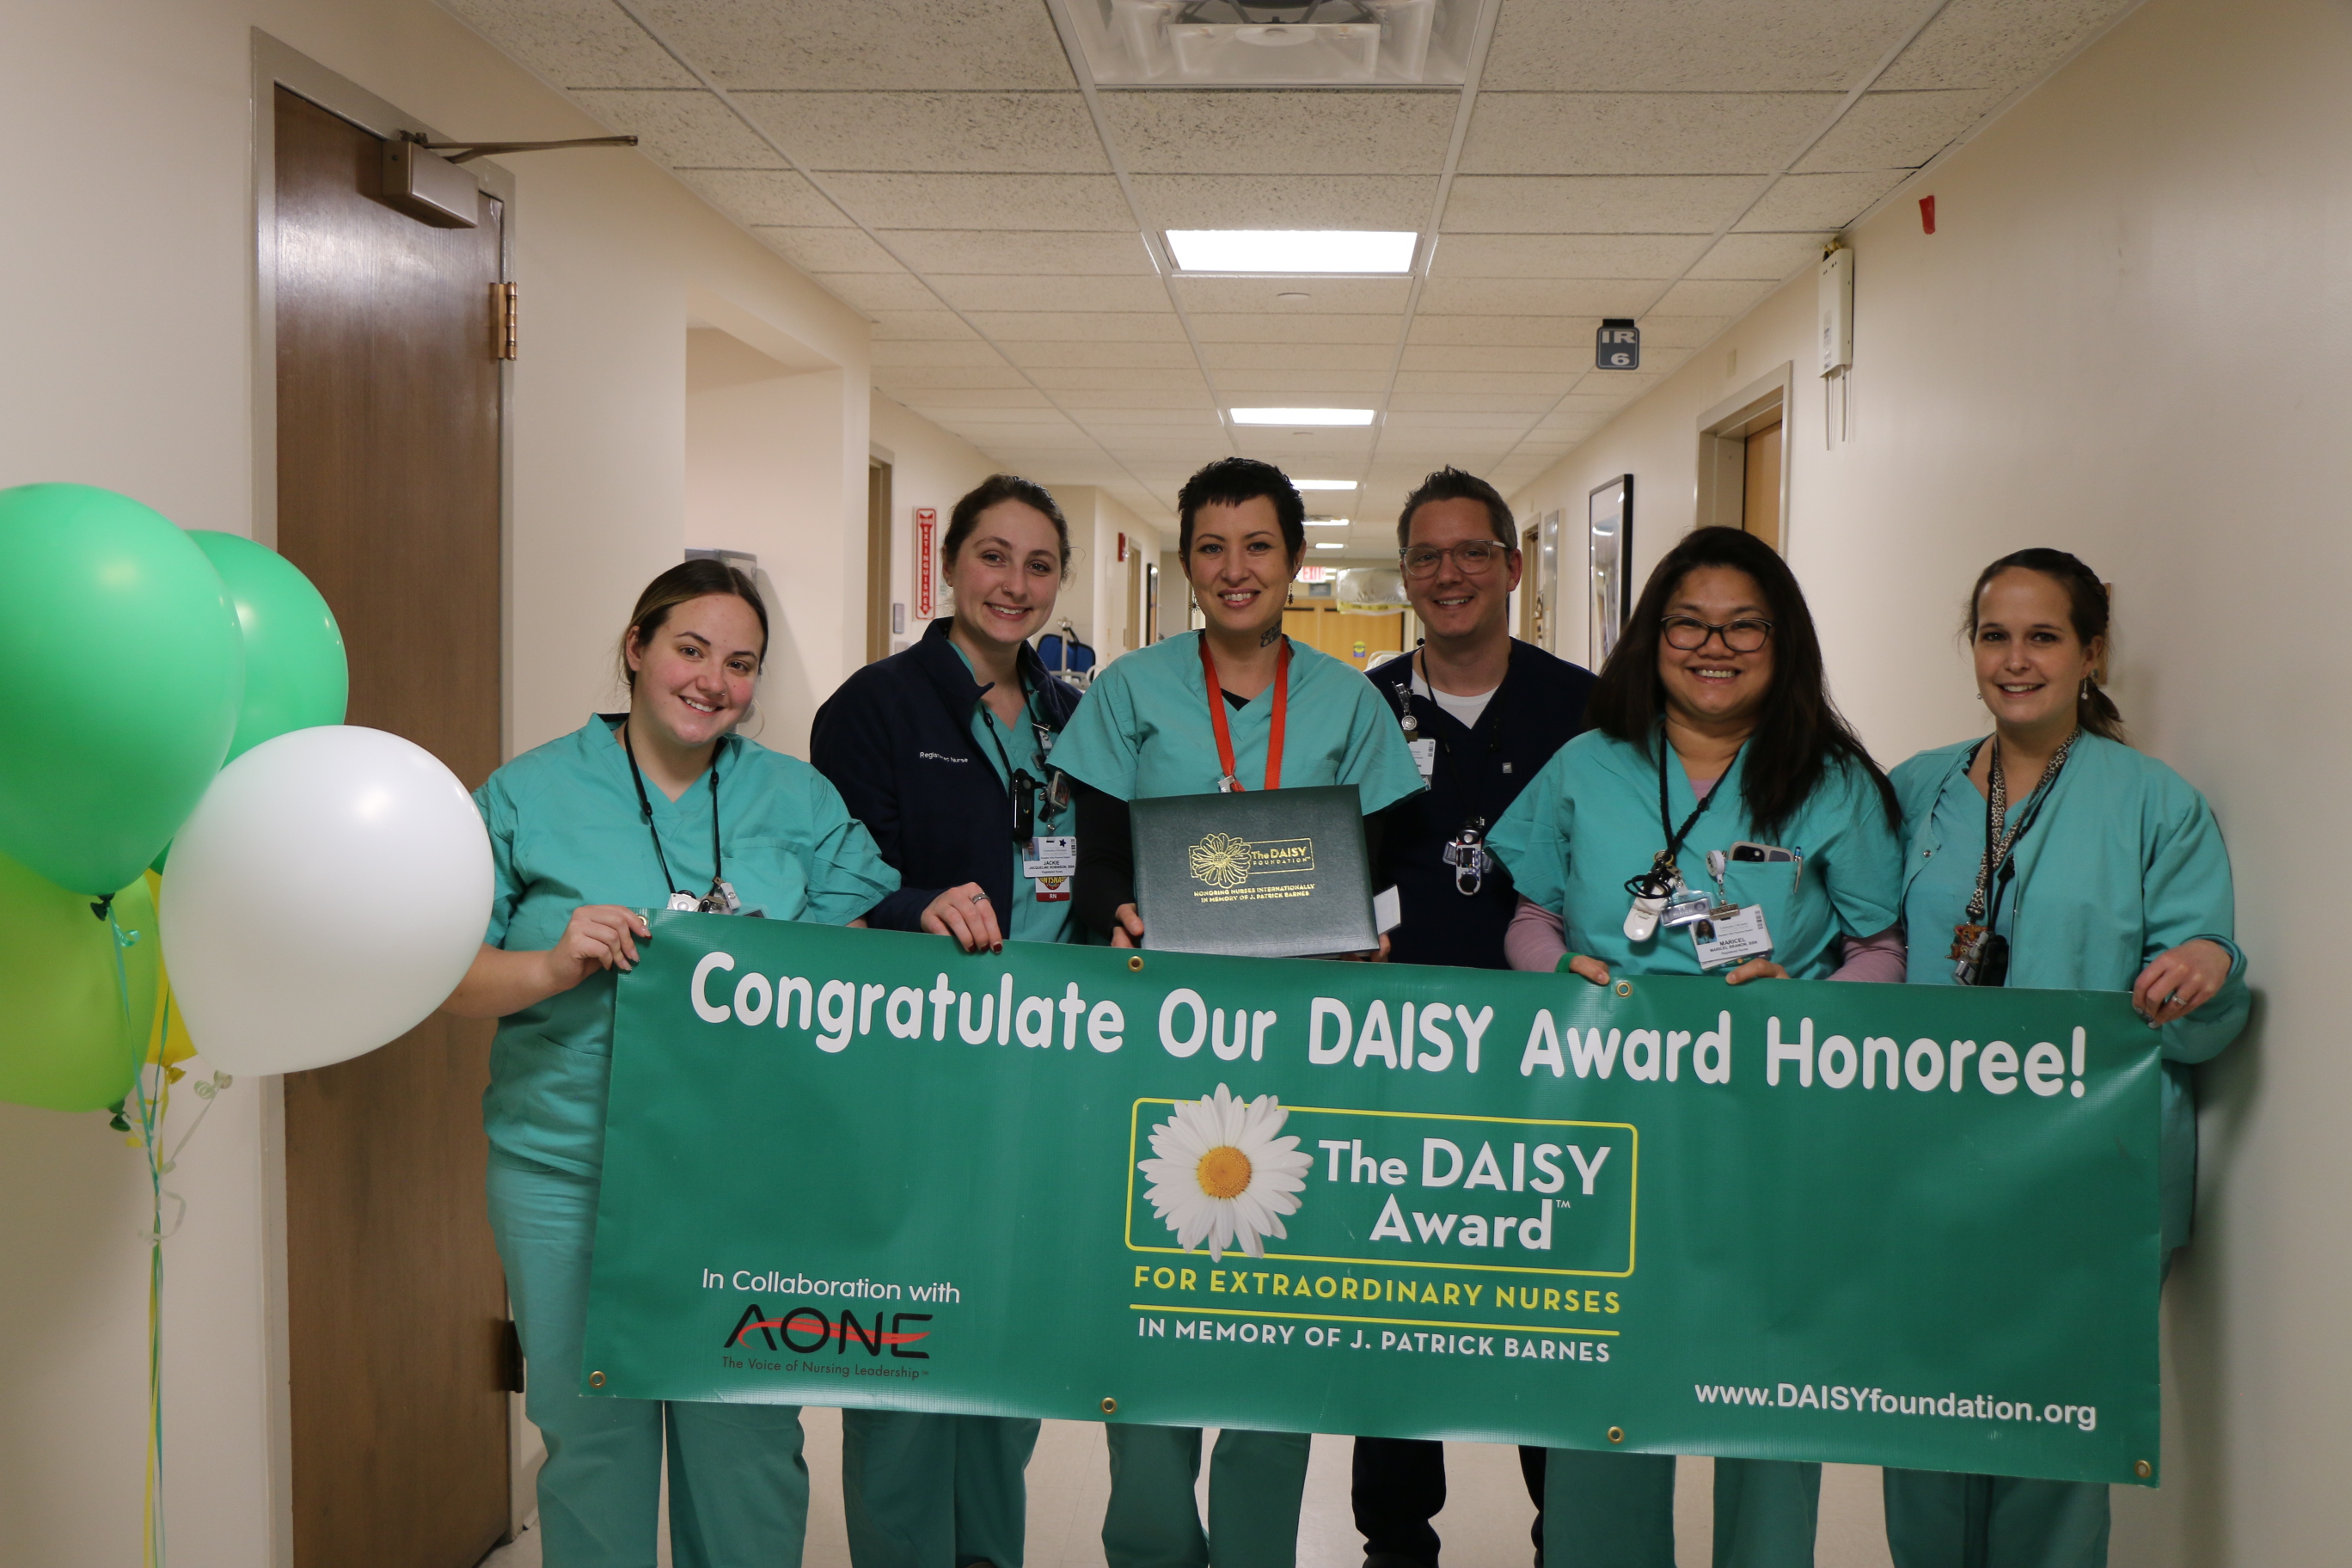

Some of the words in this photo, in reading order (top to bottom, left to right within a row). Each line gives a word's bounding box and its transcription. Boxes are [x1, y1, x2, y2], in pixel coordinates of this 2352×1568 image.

[1602, 331, 1636, 344] IR
[1610, 352, 1630, 366] 6
[1302, 566, 1322, 580] EXIT
[1251, 850, 1270, 860] The
[1270, 846, 1307, 859] DAISY
[1253, 857, 1307, 866] FOUNDATION
[1256, 883, 1315, 893] INTERNATIONALLY
[1284, 890, 1310, 898] BARNES
[691, 952, 1124, 1053] Congratulate
[1158, 989, 1277, 1061] Our
[1308, 997, 1494, 1074] DAISY
[1521, 1008, 1731, 1085] Award
[1766, 1016, 2086, 1099] Honoree!
[1318, 1139, 1408, 1185] The
[1422, 1137, 1611, 1195] DAISY
[1369, 1193, 1553, 1250] Award
[702, 1268, 725, 1289] In
[732, 1270, 901, 1300] Collaboration
[909, 1281, 960, 1303] with
[1134, 1265, 1196, 1289] FOR
[1210, 1270, 1483, 1306] EXTRAORDINARY
[1496, 1286, 1620, 1313] NURSES
[724, 1304, 934, 1358] AONE
[1138, 1317, 1165, 1338] IN
[1175, 1320, 1295, 1344] MEMORY
[1304, 1327, 1341, 1347] OF
[1350, 1330, 1371, 1350] J.
[1381, 1332, 1494, 1357] PATRICK
[1504, 1338, 1610, 1363] BARNES
[722, 1357, 744, 1369] The
[748, 1358, 781, 1371] Voice
[786, 1360, 799, 1371] of
[802, 1361, 850, 1378] Nursing
[854, 1364, 920, 1380] Leadership
[1694, 1383, 2096, 1431] www.DAISYfoundation.org
